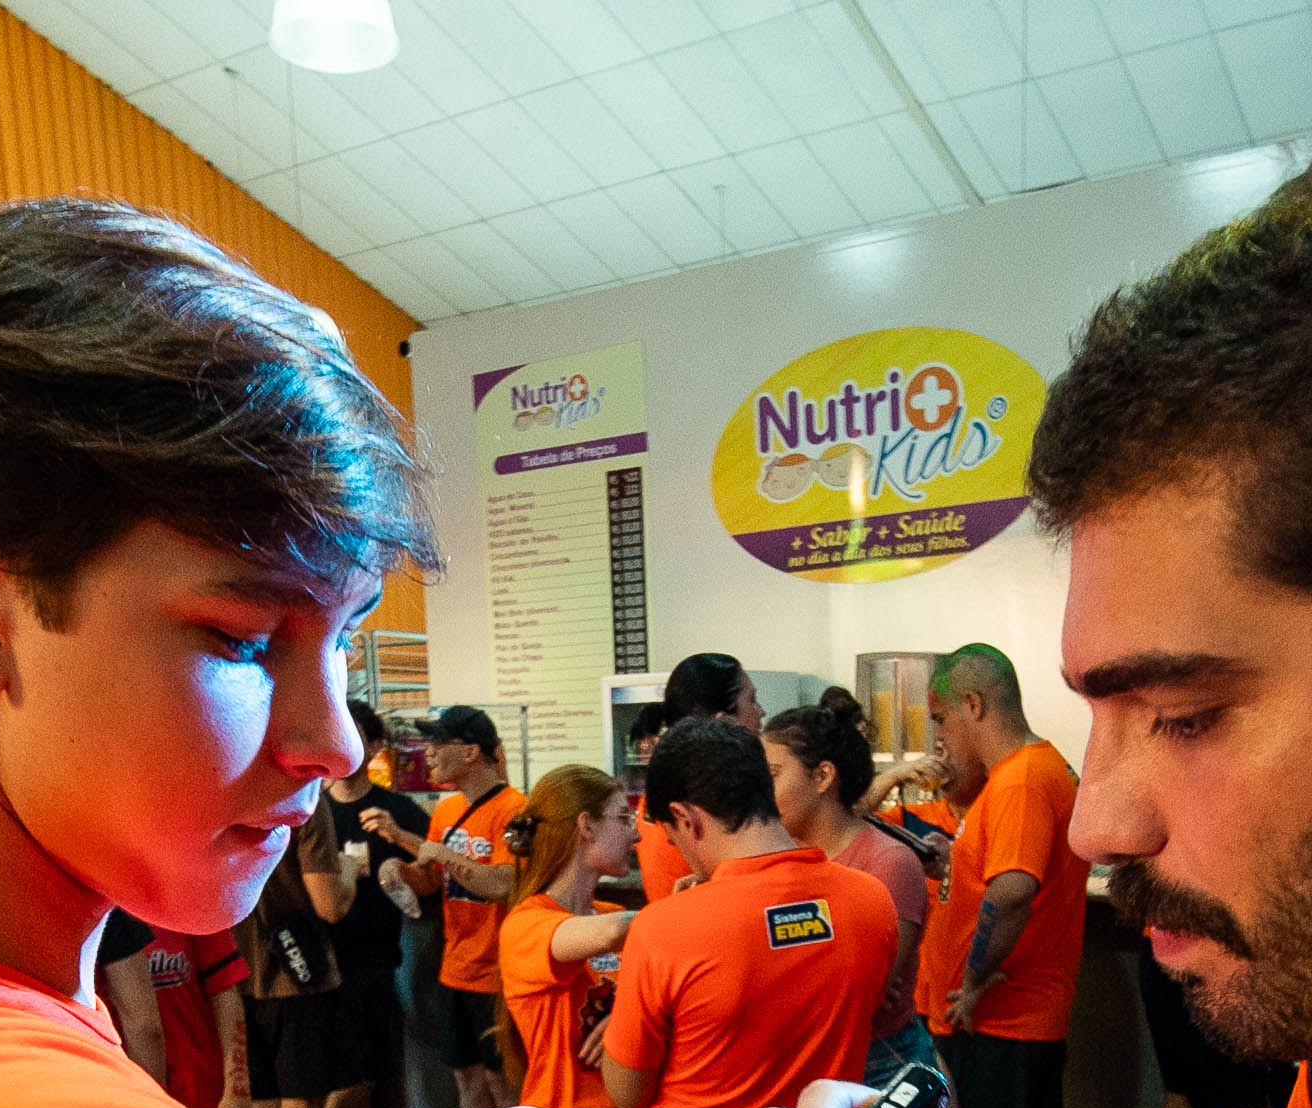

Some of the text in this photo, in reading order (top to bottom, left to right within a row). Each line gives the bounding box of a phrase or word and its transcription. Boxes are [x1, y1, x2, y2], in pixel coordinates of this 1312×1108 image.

[807, 525, 873, 550] Sabor
[895, 511, 966, 539] Saúde
[774, 912, 813, 924] Sistema
[775, 920, 825, 940] ETAPA
